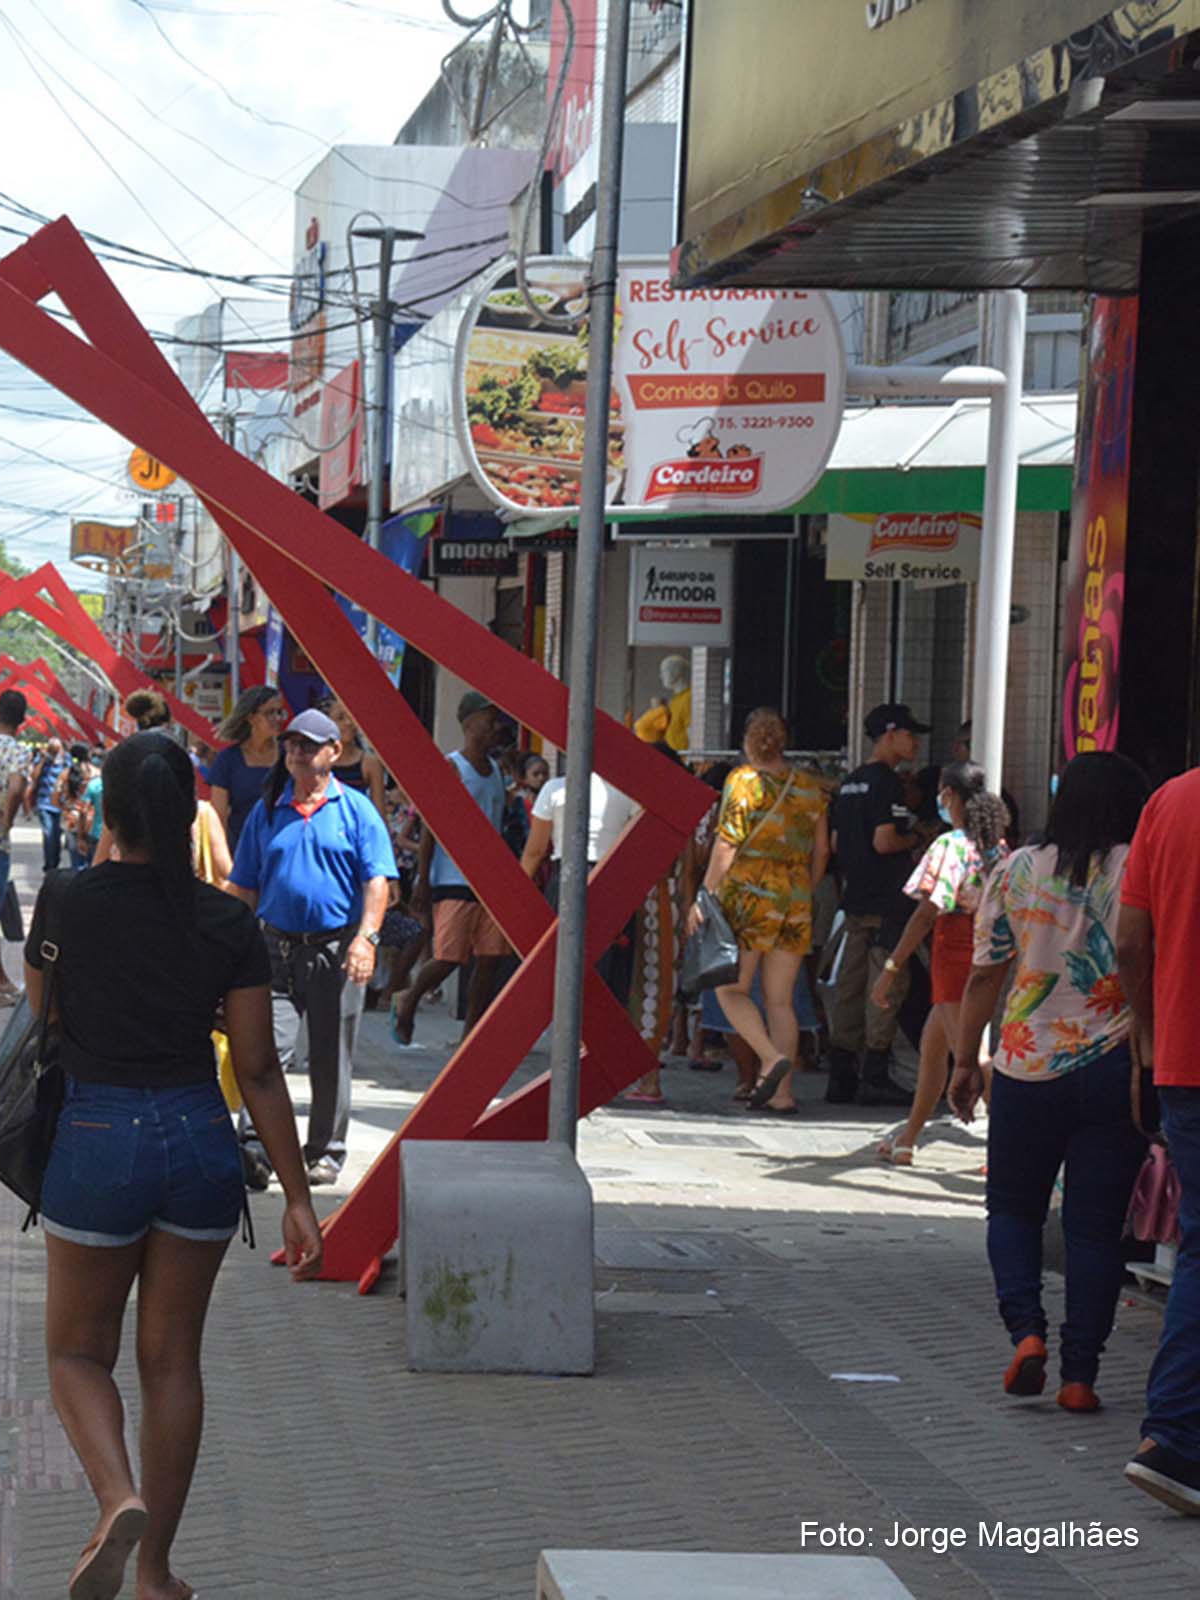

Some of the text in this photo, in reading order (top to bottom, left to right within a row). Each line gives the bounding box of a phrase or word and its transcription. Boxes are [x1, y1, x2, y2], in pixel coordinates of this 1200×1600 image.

[632, 316, 821, 370] Self-Service
[640, 382, 719, 401] Comida
[746, 380, 796, 399] Quilo
[656, 466, 754, 485] Cordeiro
[875, 517, 958, 537] Cordeiro
[865, 561, 961, 579] Self Service
